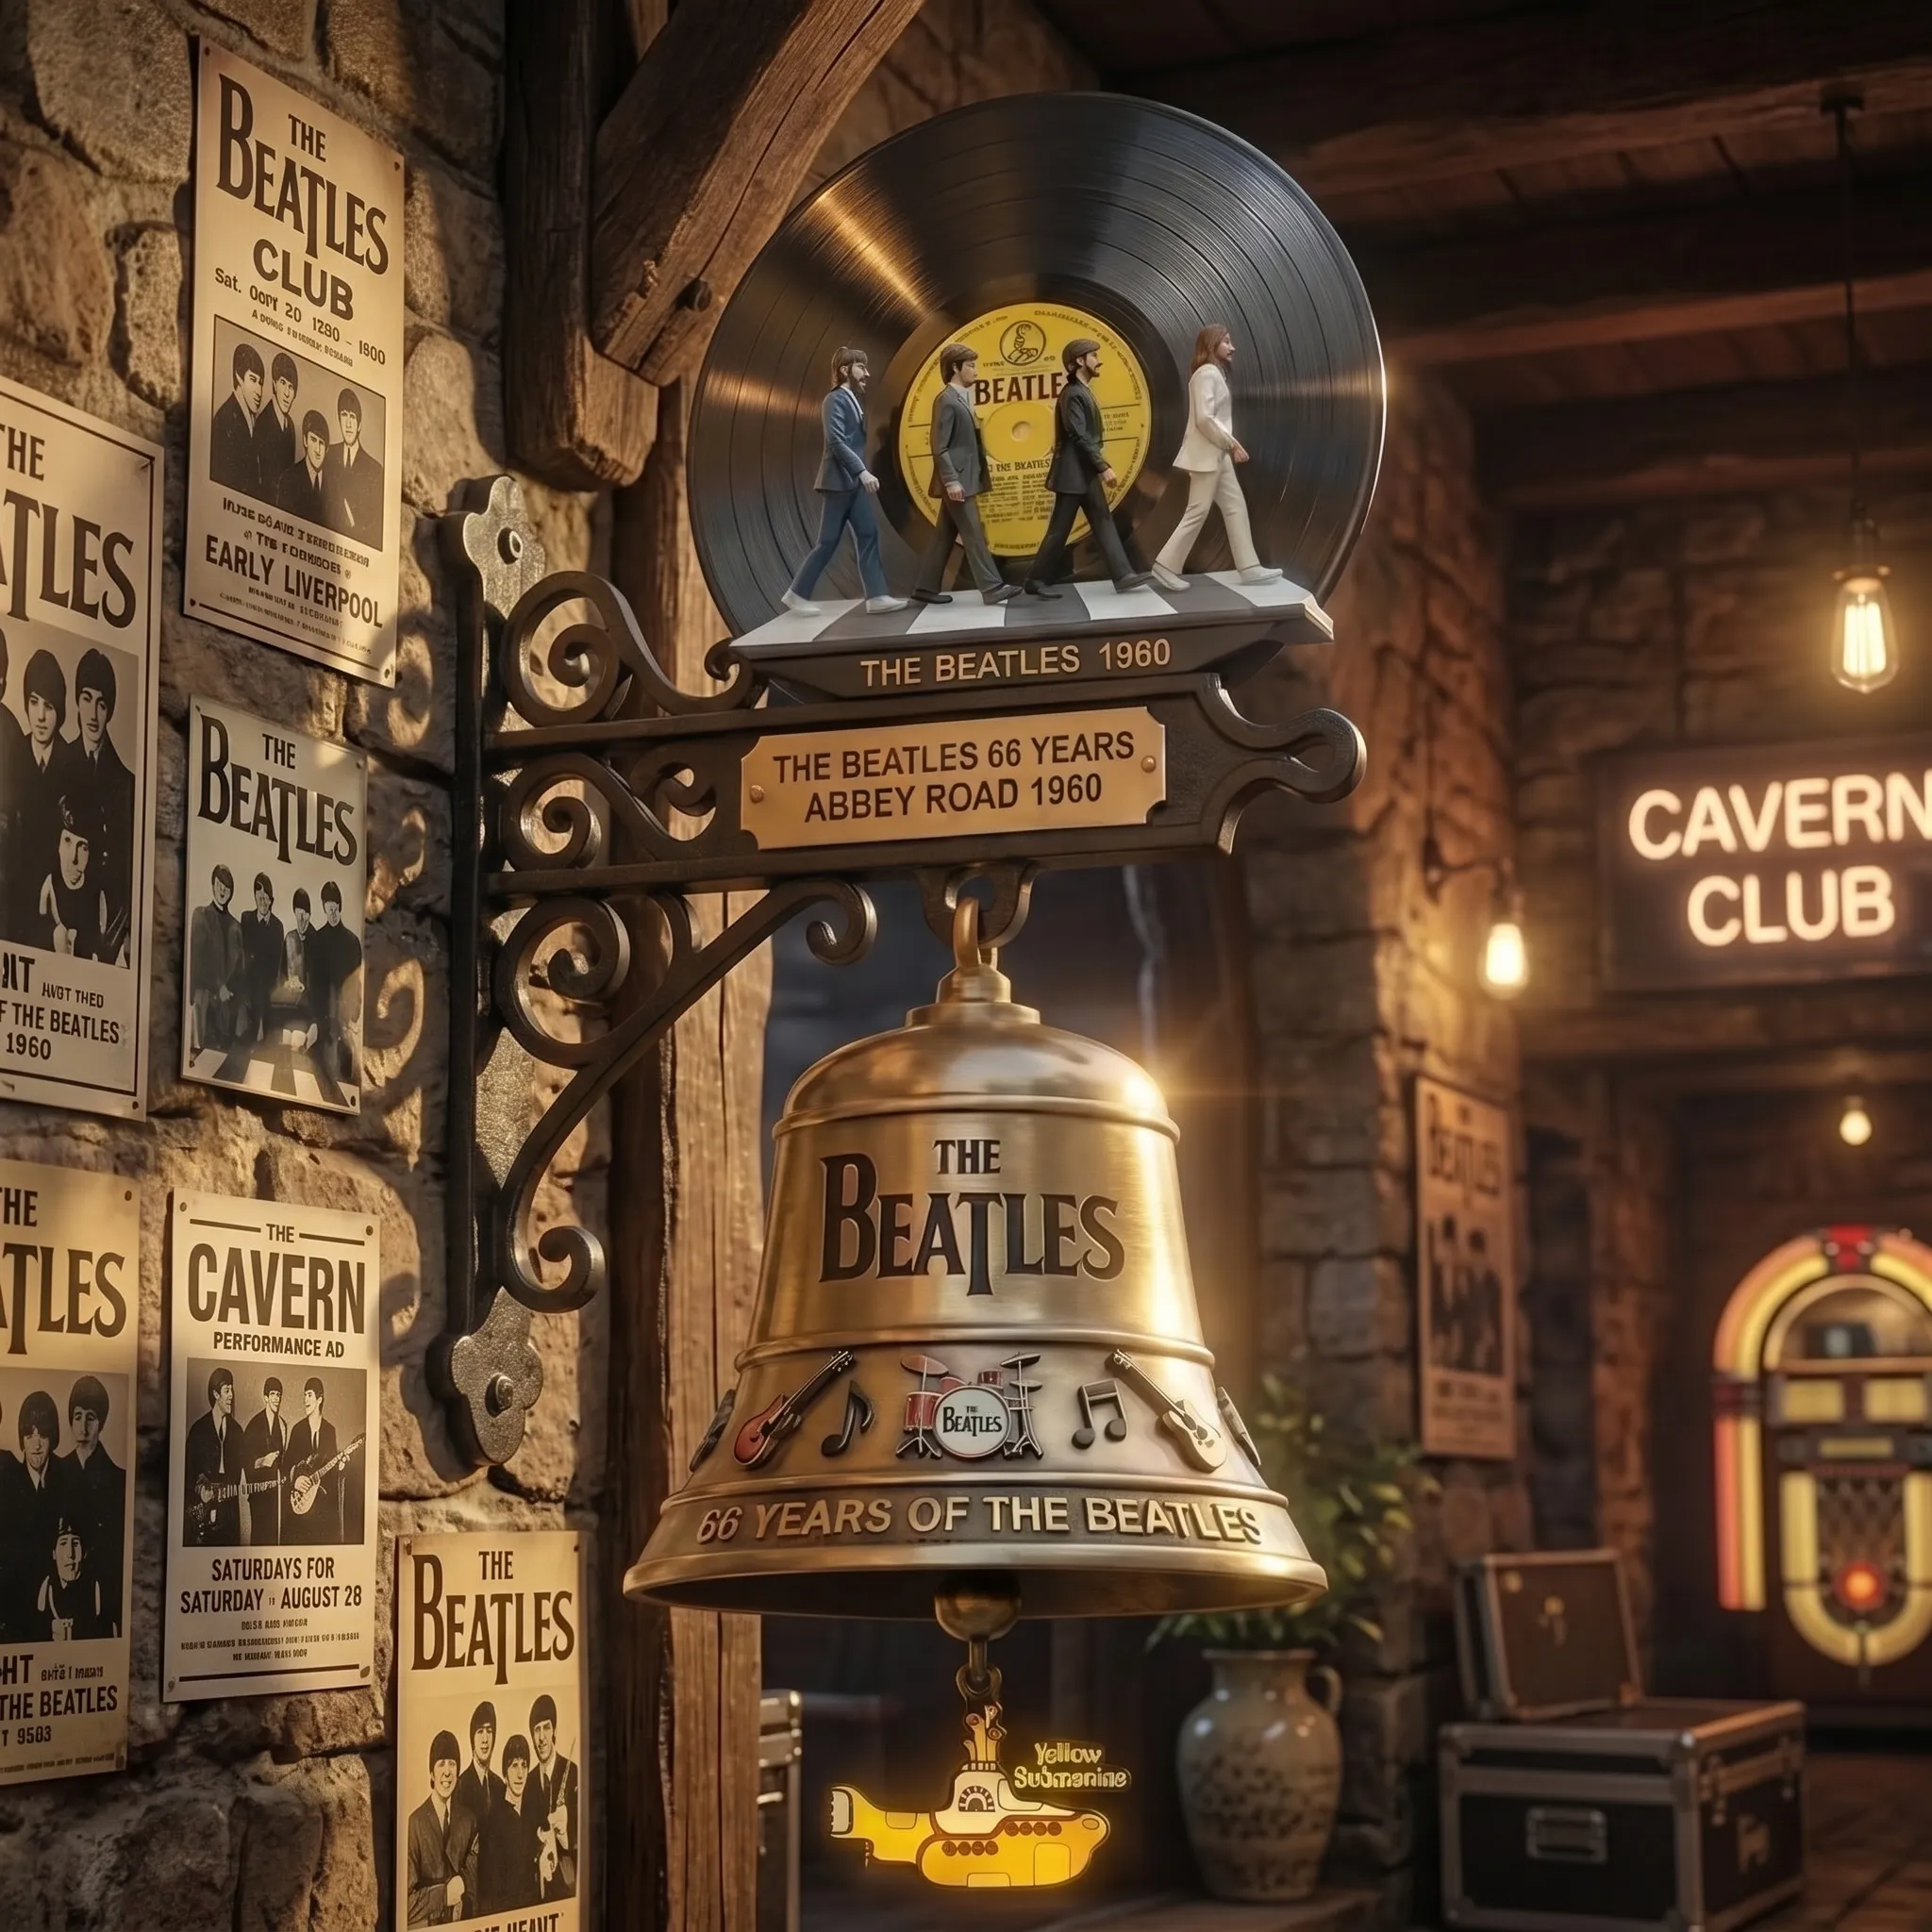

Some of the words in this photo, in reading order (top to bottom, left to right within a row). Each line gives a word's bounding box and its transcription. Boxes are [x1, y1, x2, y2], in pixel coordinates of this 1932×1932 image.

[288, 113, 326, 162] THE
[215, 73, 389, 275] BEATLES
[214, 267, 242, 293] Sat.
[285, 302, 302, 323] 20
[253, 239, 354, 321] CLUB
[0, 424, 45, 481] HE
[0, 489, 136, 629] TLES
[205, 534, 275, 586] EARLY
[284, 564, 383, 628] LIVERPOOL
[860, 658, 921, 688] THE
[935, 644, 1080, 682] BEATLES
[1098, 639, 1171, 671] 1960
[261, 733, 295, 769] THE
[773, 753, 831, 783] THE
[842, 741, 978, 779] BEATLES
[987, 739, 1022, 768] 66
[1031, 730, 1135, 765] YEARS
[197, 714, 358, 866] BEATLES
[805, 786, 917, 823] ABBEY
[925, 778, 1018, 814] ROAD
[1030, 773, 1102, 806] 1960
[1628, 769, 1932, 860] CAVERN
[1688, 865, 1895, 947] CLUB
[6, 1032, 52, 1060] 1960
[12, 1002, 45, 1030] THE
[50, 1009, 120, 1044] BEATLES
[931, 1139, 1001, 1174] THE
[0, 1187, 38, 1226] HE
[819, 1152, 1124, 1296] BEATLES
[265, 1223, 295, 1243] THE
[0, 1241, 127, 1355] TLES
[188, 1242, 365, 1334] CAVERN
[213, 1331, 322, 1357] PERFORMANCE
[325, 1341, 345, 1357] AD
[942, 1406, 1003, 1437] BEATLES
[696, 1506, 743, 1544] 66
[755, 1498, 892, 1539] YEARS
[907, 1496, 971, 1532] OF
[982, 1495, 1070, 1532] THE
[1083, 1496, 1263, 1545] BEATLES
[211, 1557, 302, 1582] SATURDAYS
[307, 1557, 335, 1579] FOR
[478, 1551, 513, 1580] THE
[180, 1589, 264, 1614] SATURDAY
[280, 1586, 341, 1609] AUGUST
[344, 1585, 362, 1607] 28
[411, 1554, 575, 1685] BEATLES
[0, 1654, 34, 1685] HT
[0, 1692, 33, 1721] THE
[40, 1685, 118, 1717] BEATLES
[1034, 1742, 1102, 1766] Yellow
